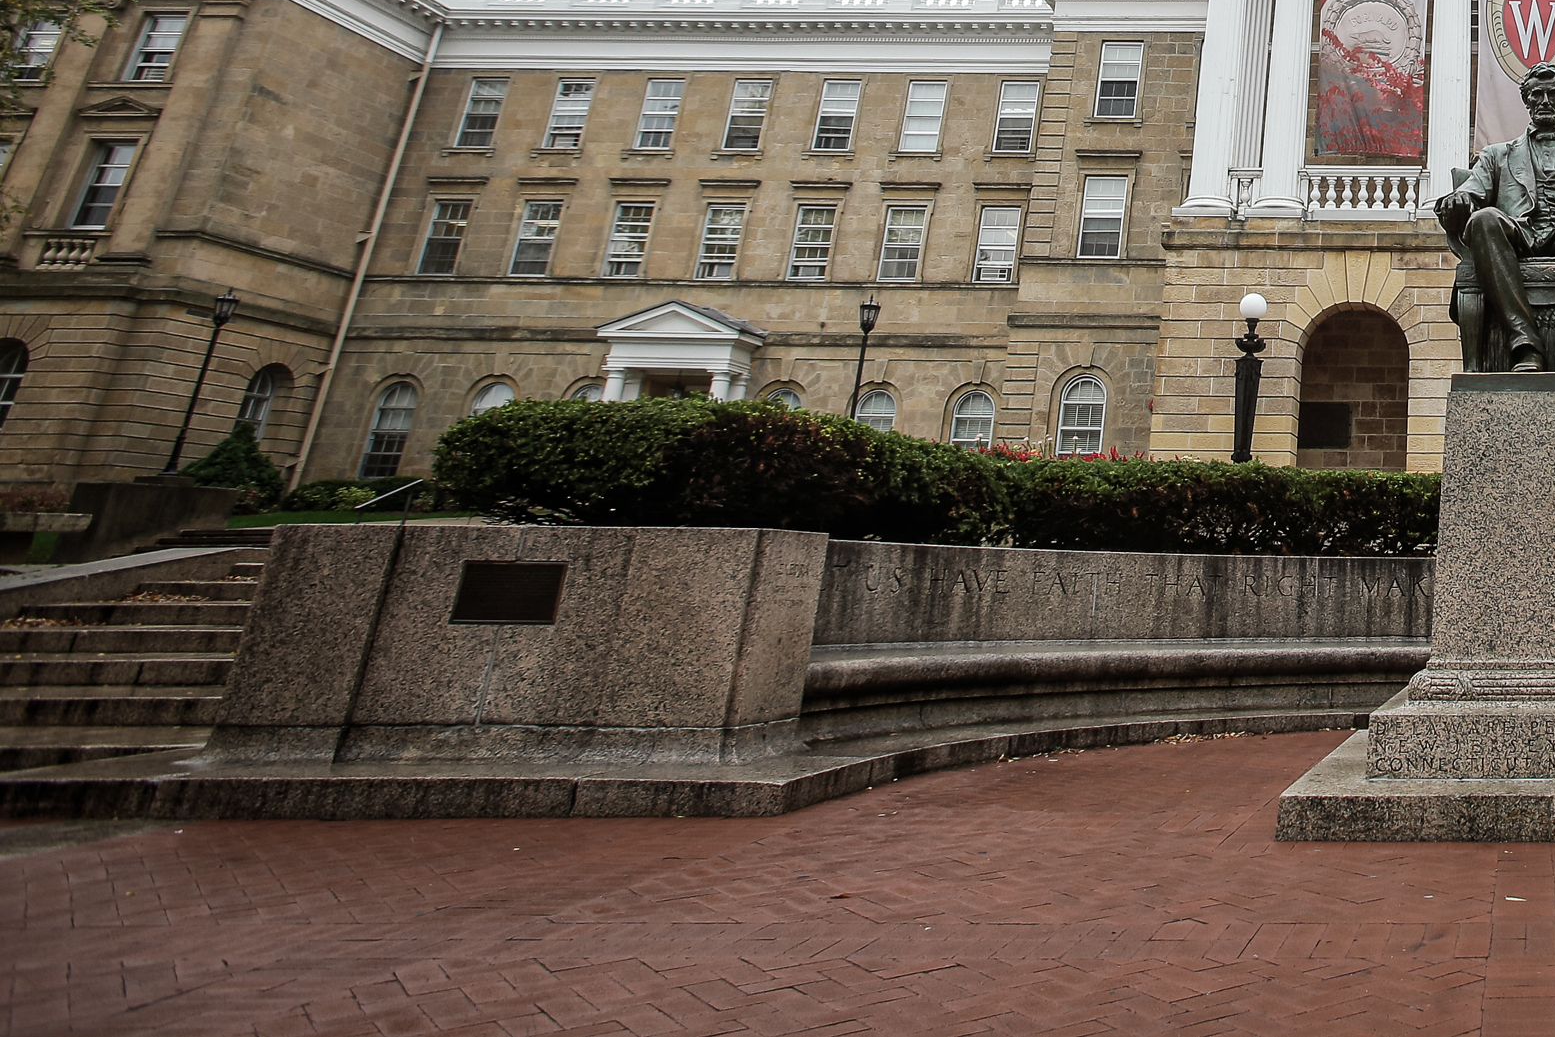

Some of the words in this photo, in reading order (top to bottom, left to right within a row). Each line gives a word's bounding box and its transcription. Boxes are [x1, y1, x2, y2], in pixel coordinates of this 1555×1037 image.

[1349, 12, 1399, 32] FORWARD
[865, 564, 901, 592] US
[928, 568, 1010, 595] HAVE
[1031, 571, 1122, 596] FAITH
[1146, 573, 1223, 597] THAT
[1243, 575, 1337, 599] RIGHT
[1376, 720, 1515, 735] DELAWARE
[1375, 739, 1438, 753] NEW
[1375, 757, 1531, 772] CONNECTICUT
